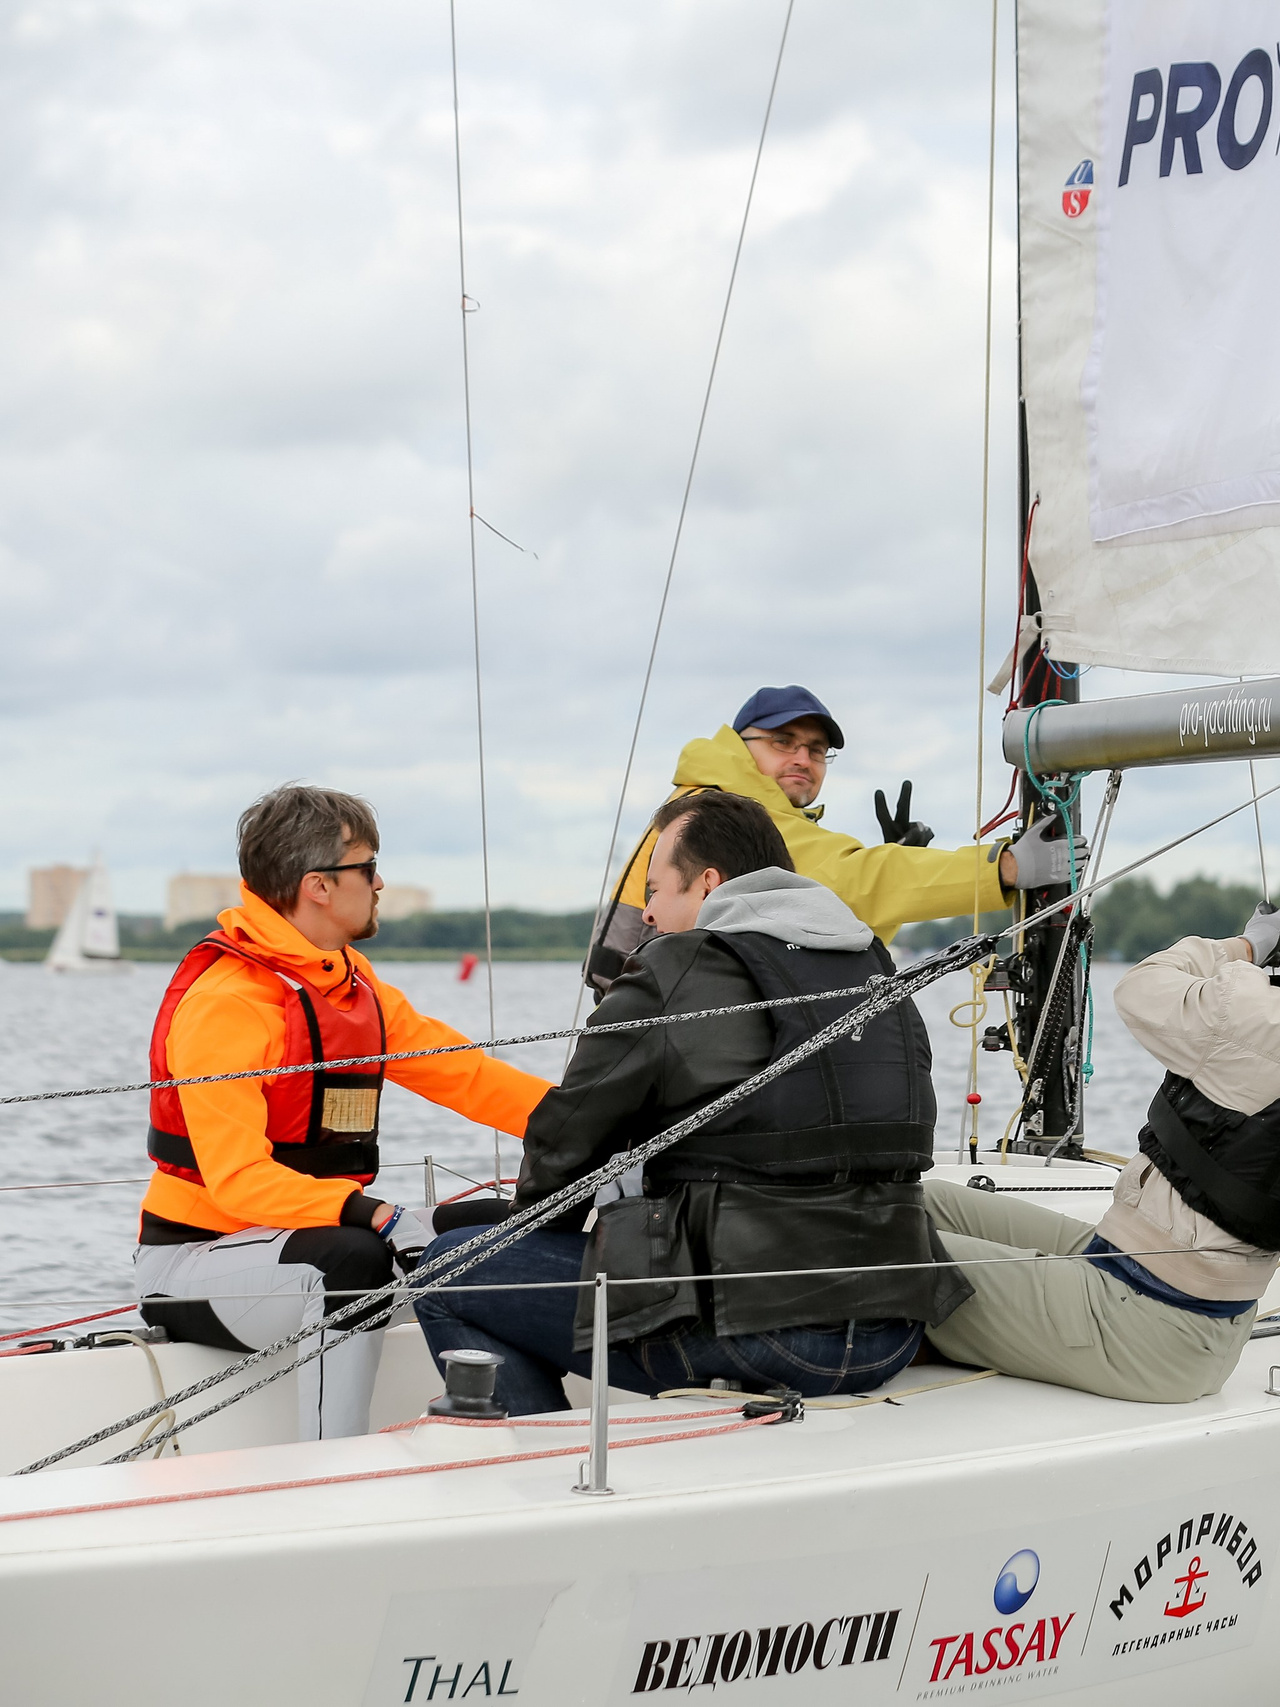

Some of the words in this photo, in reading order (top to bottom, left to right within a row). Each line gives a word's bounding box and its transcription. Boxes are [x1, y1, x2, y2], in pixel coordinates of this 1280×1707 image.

[1180, 688, 1272, 747] pro-yachting.ru
[1109, 1512, 1263, 1621] МОРПРИБОР
[630, 1608, 902, 1695] ВЕДОМОСТИ
[928, 1612, 1077, 1682] TASSAY
[1111, 1623, 1202, 1656] ЛЕГЕНДАРНЫЕ
[1206, 1613, 1239, 1632] ЧАСЫ
[916, 1684, 965, 1701] PREMIUM
[970, 1673, 1022, 1691] DRINKING
[1027, 1665, 1059, 1680] WATER
